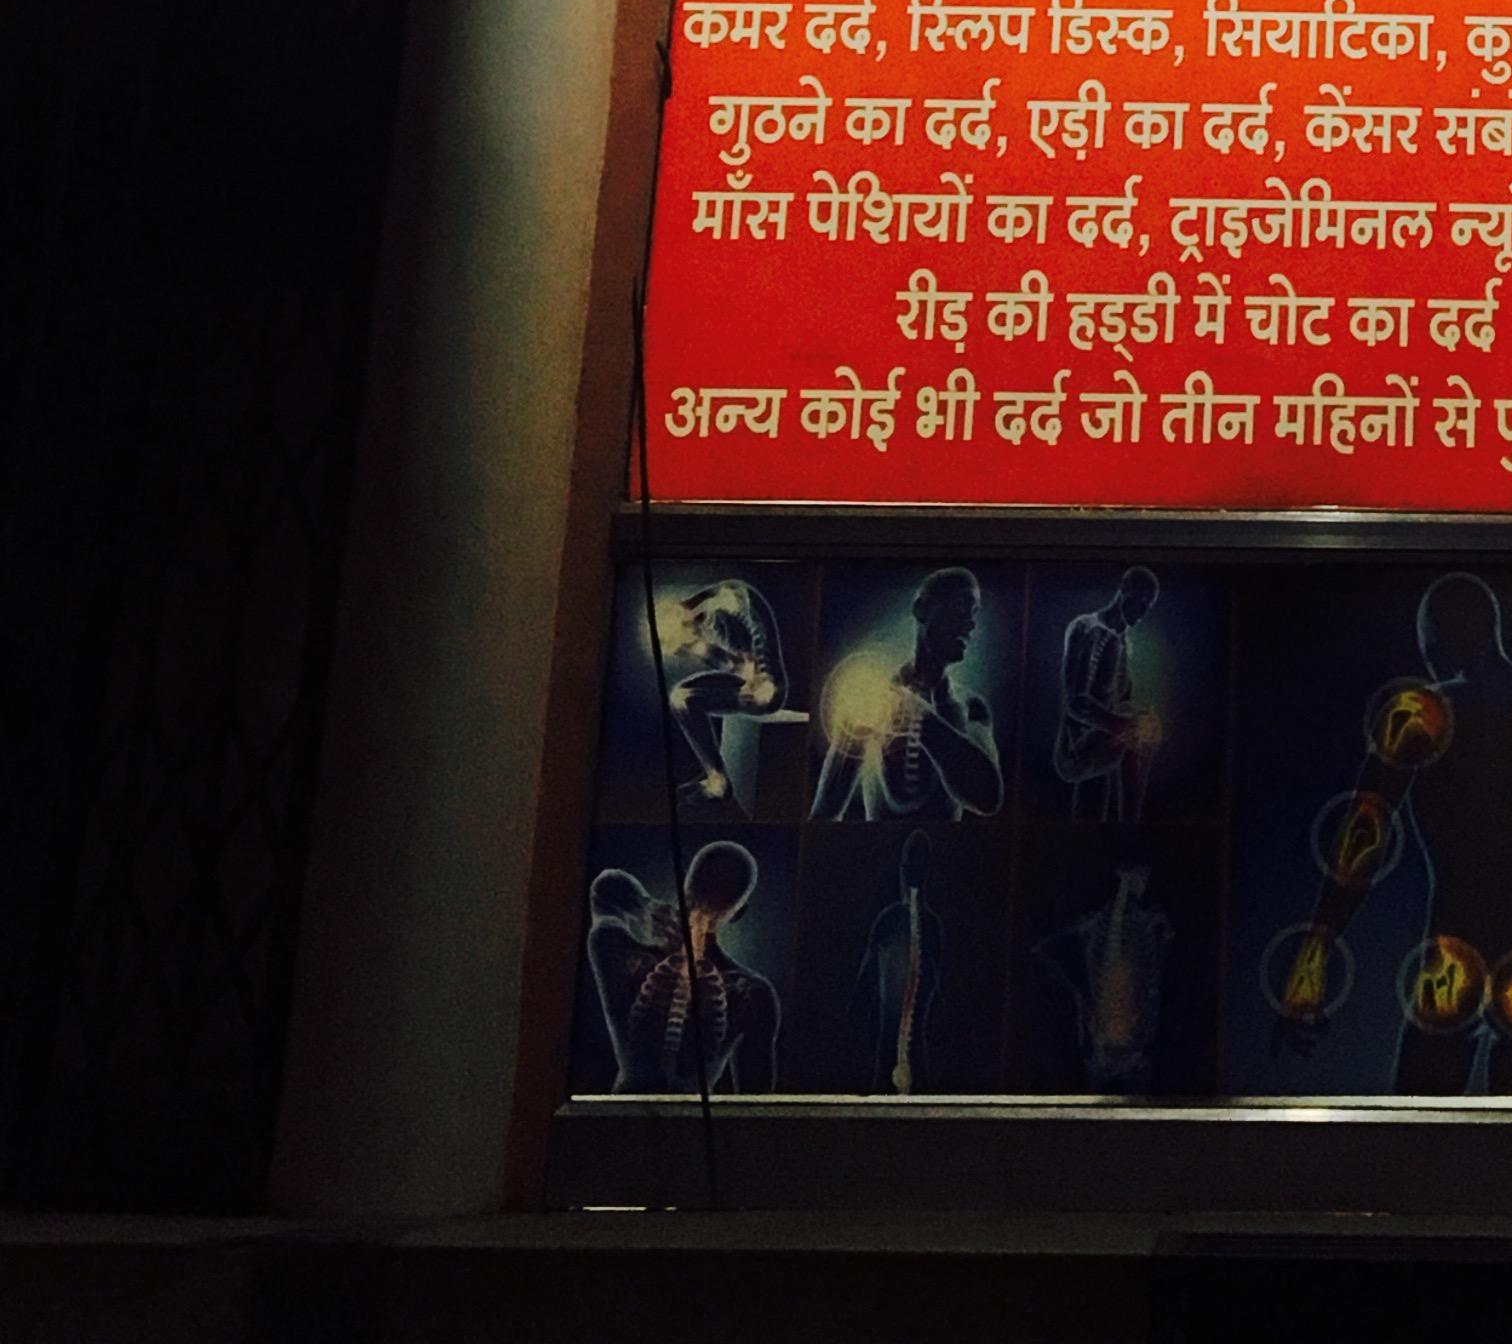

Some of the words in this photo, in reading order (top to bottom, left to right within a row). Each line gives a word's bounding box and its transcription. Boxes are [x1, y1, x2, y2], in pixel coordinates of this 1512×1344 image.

[683, 2, 792, 50] कमर
[1304, 83, 1422, 154] केंसर
[692, 169, 794, 240] माँस
[806, 170, 974, 244] पेशियों
[1170, 177, 1437, 262] ट्राइजेमिनल
[985, 270, 1054, 342] की
[1193, 272, 1232, 345] में
[1244, 274, 1335, 346] चोट
[664, 386, 788, 439] अन्य
[800, 366, 906, 452] कोई
[916, 367, 981, 441] भी
[1080, 369, 1148, 444] जो
[1161, 370, 1260, 445] तीन
[1273, 372, 1420, 454] महिनों
